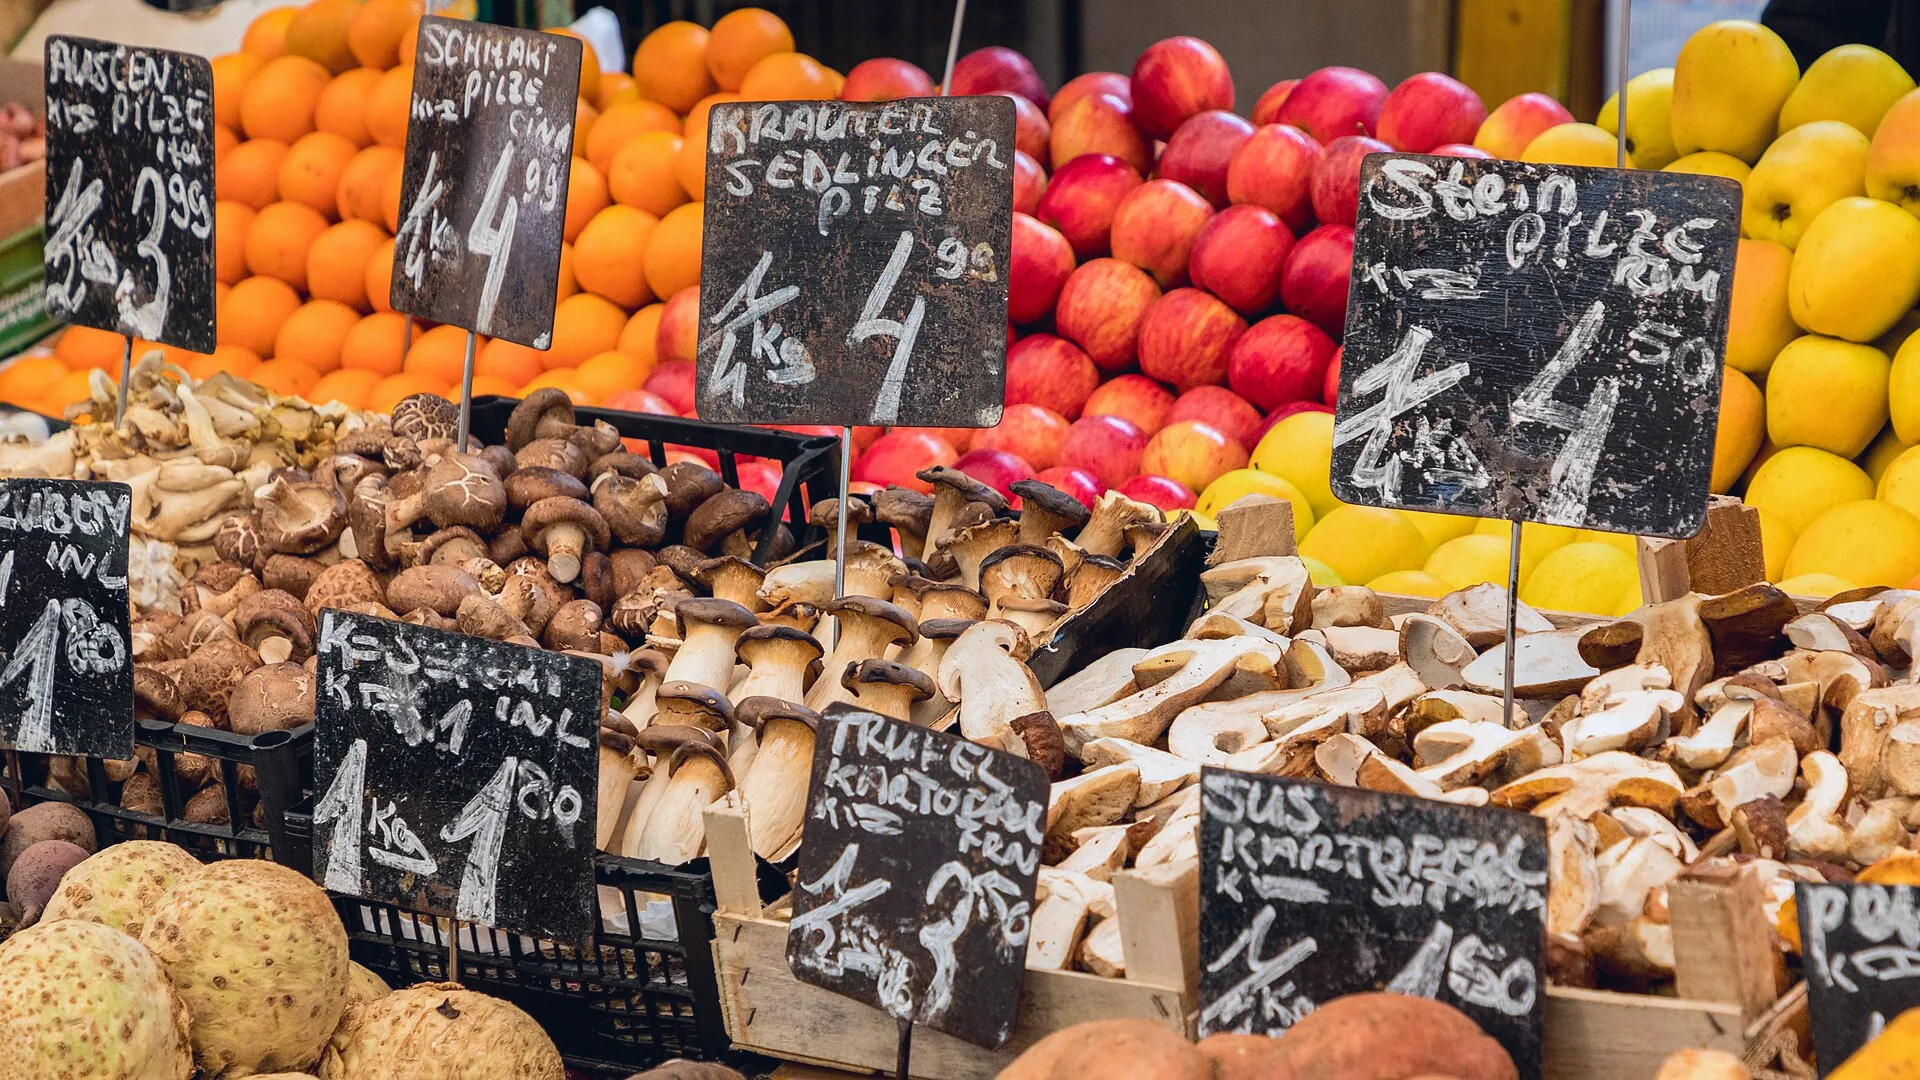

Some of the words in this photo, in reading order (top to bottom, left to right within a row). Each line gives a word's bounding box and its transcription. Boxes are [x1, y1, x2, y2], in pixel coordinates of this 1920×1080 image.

[116, 165, 171, 341] 3
[168, 172, 211, 240] 99
[468, 140, 519, 334] 4
[846, 230, 926, 425] 4
[1510, 300, 1621, 524] 4
[0, 598, 61, 752] 1
[313, 738, 367, 896] 1
[440, 756, 517, 928] 1
[1384, 919, 1453, 1000] 1
